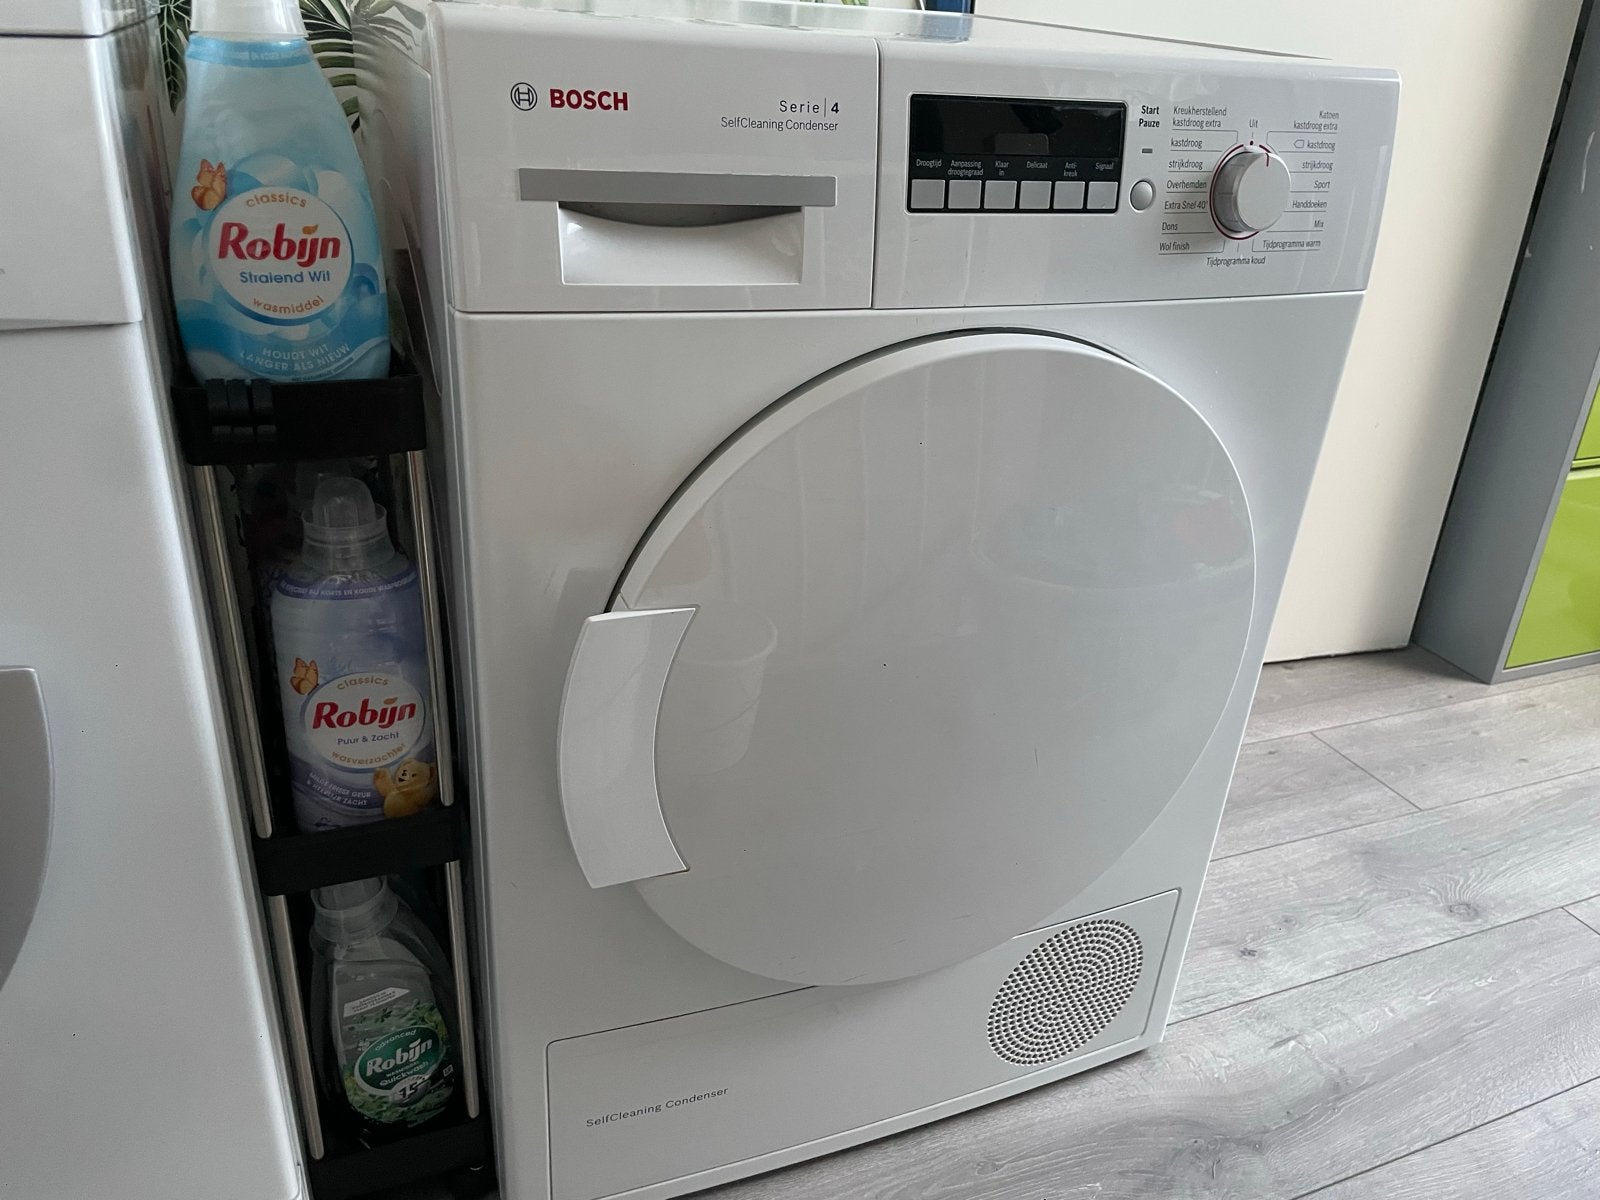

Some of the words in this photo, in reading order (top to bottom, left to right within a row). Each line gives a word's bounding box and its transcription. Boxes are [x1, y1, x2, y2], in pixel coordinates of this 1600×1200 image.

[550, 88, 628, 111] BOSCH
[779, 100, 820, 114] Serie
[1141, 105, 1160, 115] Start
[1174, 105, 1227, 116] Kreukherstellend
[1319, 110, 1340, 120] Katoen
[720, 116, 784, 132] SelfCleaning
[786, 118, 838, 132] Condenser
[1138, 118, 1160, 128] Pauze
[1172, 118, 1204, 128] kastdroog
[1206, 120, 1222, 128] extra
[1249, 119, 1258, 128] Uit
[1293, 120, 1322, 130] kastdroog
[1323, 122, 1338, 131] extra
[1170, 138, 1202, 148] kastdroog
[1307, 140, 1336, 150] kastdroog
[916, 158, 942, 168] Droogtijd
[950, 160, 982, 169] Aanpassing
[995, 160, 1010, 168] Klaar
[1095, 162, 1114, 170] Signaal
[1168, 160, 1203, 170] strijkdroog
[1302, 160, 1334, 171] strijkdroog
[948, 168, 984, 177] droogtegraad
[999, 168, 1005, 176] in
[1064, 169, 1078, 177] kreuk
[1166, 180, 1207, 189] Overhemden
[1314, 180, 1330, 190] Sport
[246, 191, 307, 208] classics
[1292, 200, 1328, 208] Handdoeken
[1164, 200, 1181, 210] Extra
[1162, 222, 1178, 230] Dons
[1314, 220, 1324, 228] Mix
[218, 222, 340, 268] Robijn
[1159, 242, 1171, 251] Wol
[1172, 242, 1190, 250] finish
[1262, 240, 1304, 249] Tijdprogramma
[1206, 257, 1250, 266] Tijdprogramma
[1251, 256, 1266, 264] koud
[240, 270, 304, 284] Stralend
[308, 270, 331, 283] Wit
[252, 296, 324, 315] wasmiddel
[240, 351, 289, 370] LANGER
[317, 344, 351, 366] NIEUW
[262, 348, 306, 360] HOUDT
[311, 344, 329, 358] WIT
[337, 676, 389, 690] classics
[312, 696, 417, 729] Robijn
[337, 736, 359, 746] Puur
[371, 731, 400, 742] Zacht
[331, 743, 406, 765] wasverzachter
[366, 1038, 433, 1077] Robijn
[379, 1061, 429, 1086] Quickwash
[586, 1104, 662, 1127] SelfCleaning
[665, 1087, 729, 1108] Condenser
